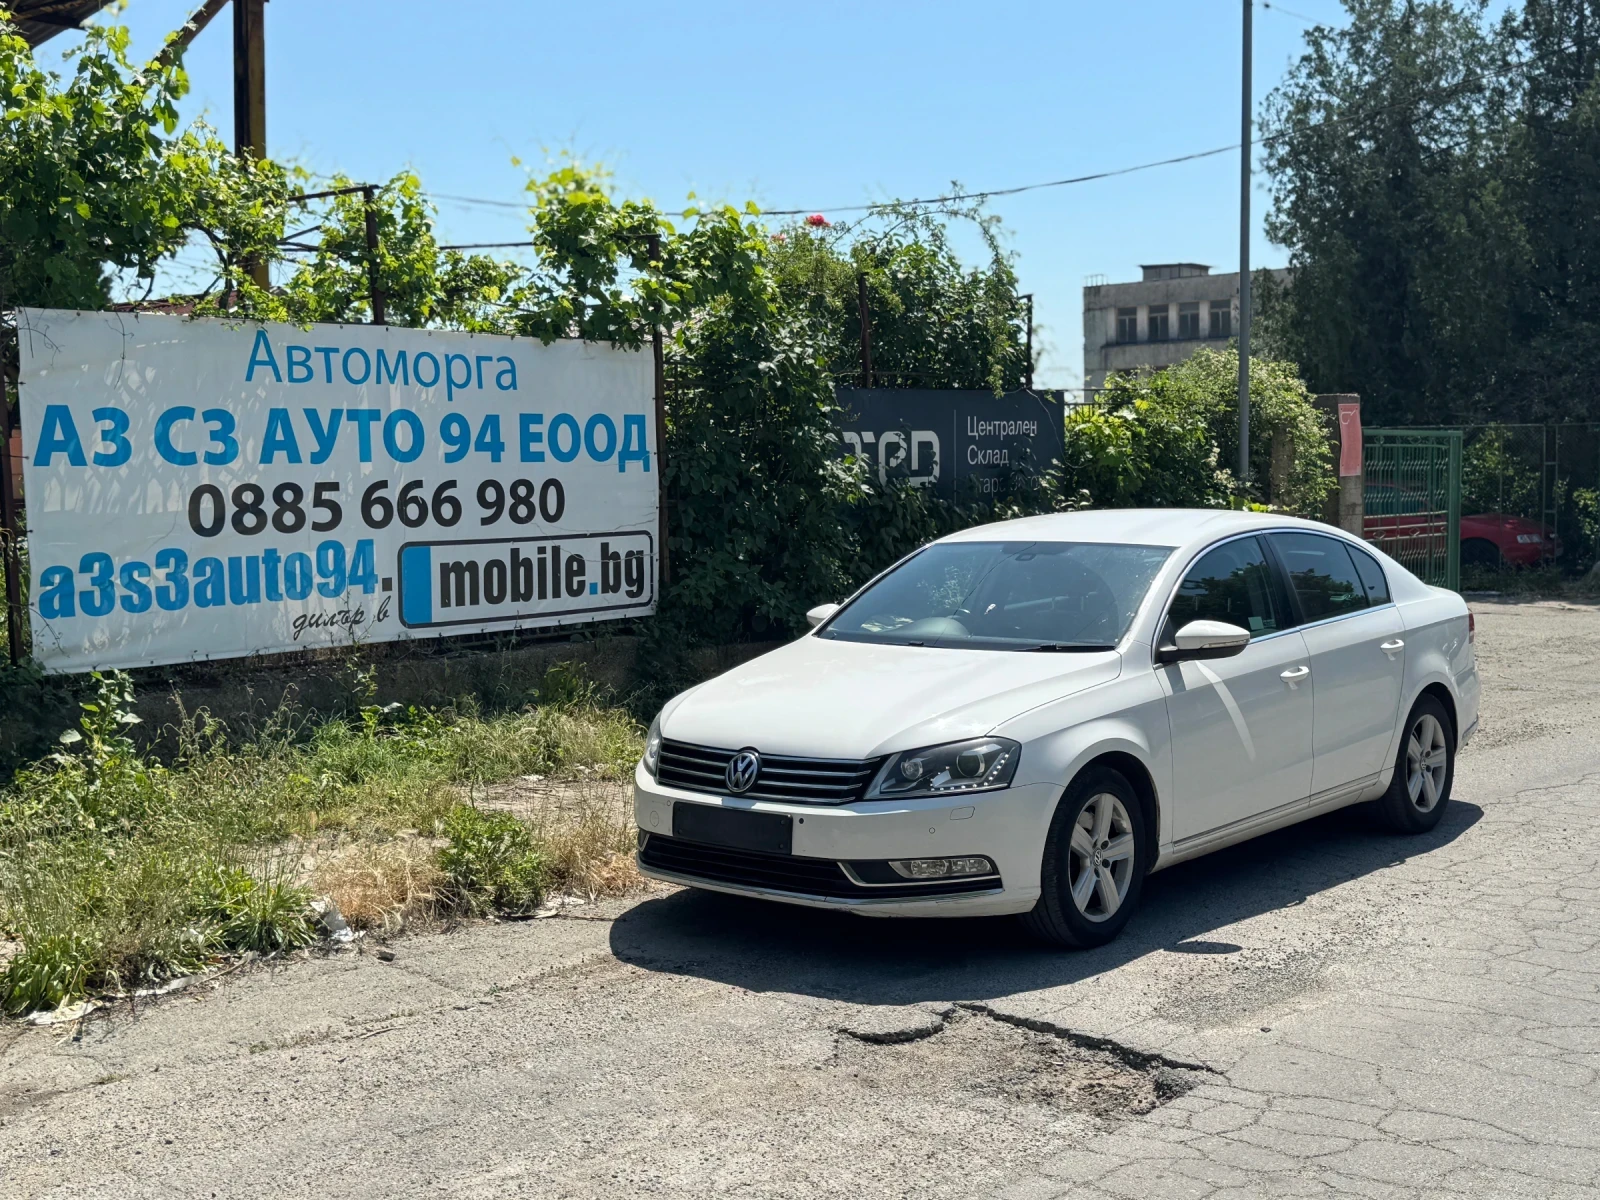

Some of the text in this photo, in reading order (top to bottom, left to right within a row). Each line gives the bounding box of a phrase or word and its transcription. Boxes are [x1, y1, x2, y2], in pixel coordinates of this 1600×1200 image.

[246, 331, 518, 401] Автоморга
[260, 408, 426, 465] АУТО
[440, 412, 506, 464] 94
[519, 413, 651, 473] ЕООД
[967, 415, 1037, 440] Централен
[967, 445, 1009, 466] Склад
[189, 478, 565, 538] 0885 666 980
[440, 542, 645, 609] mobile.bg
